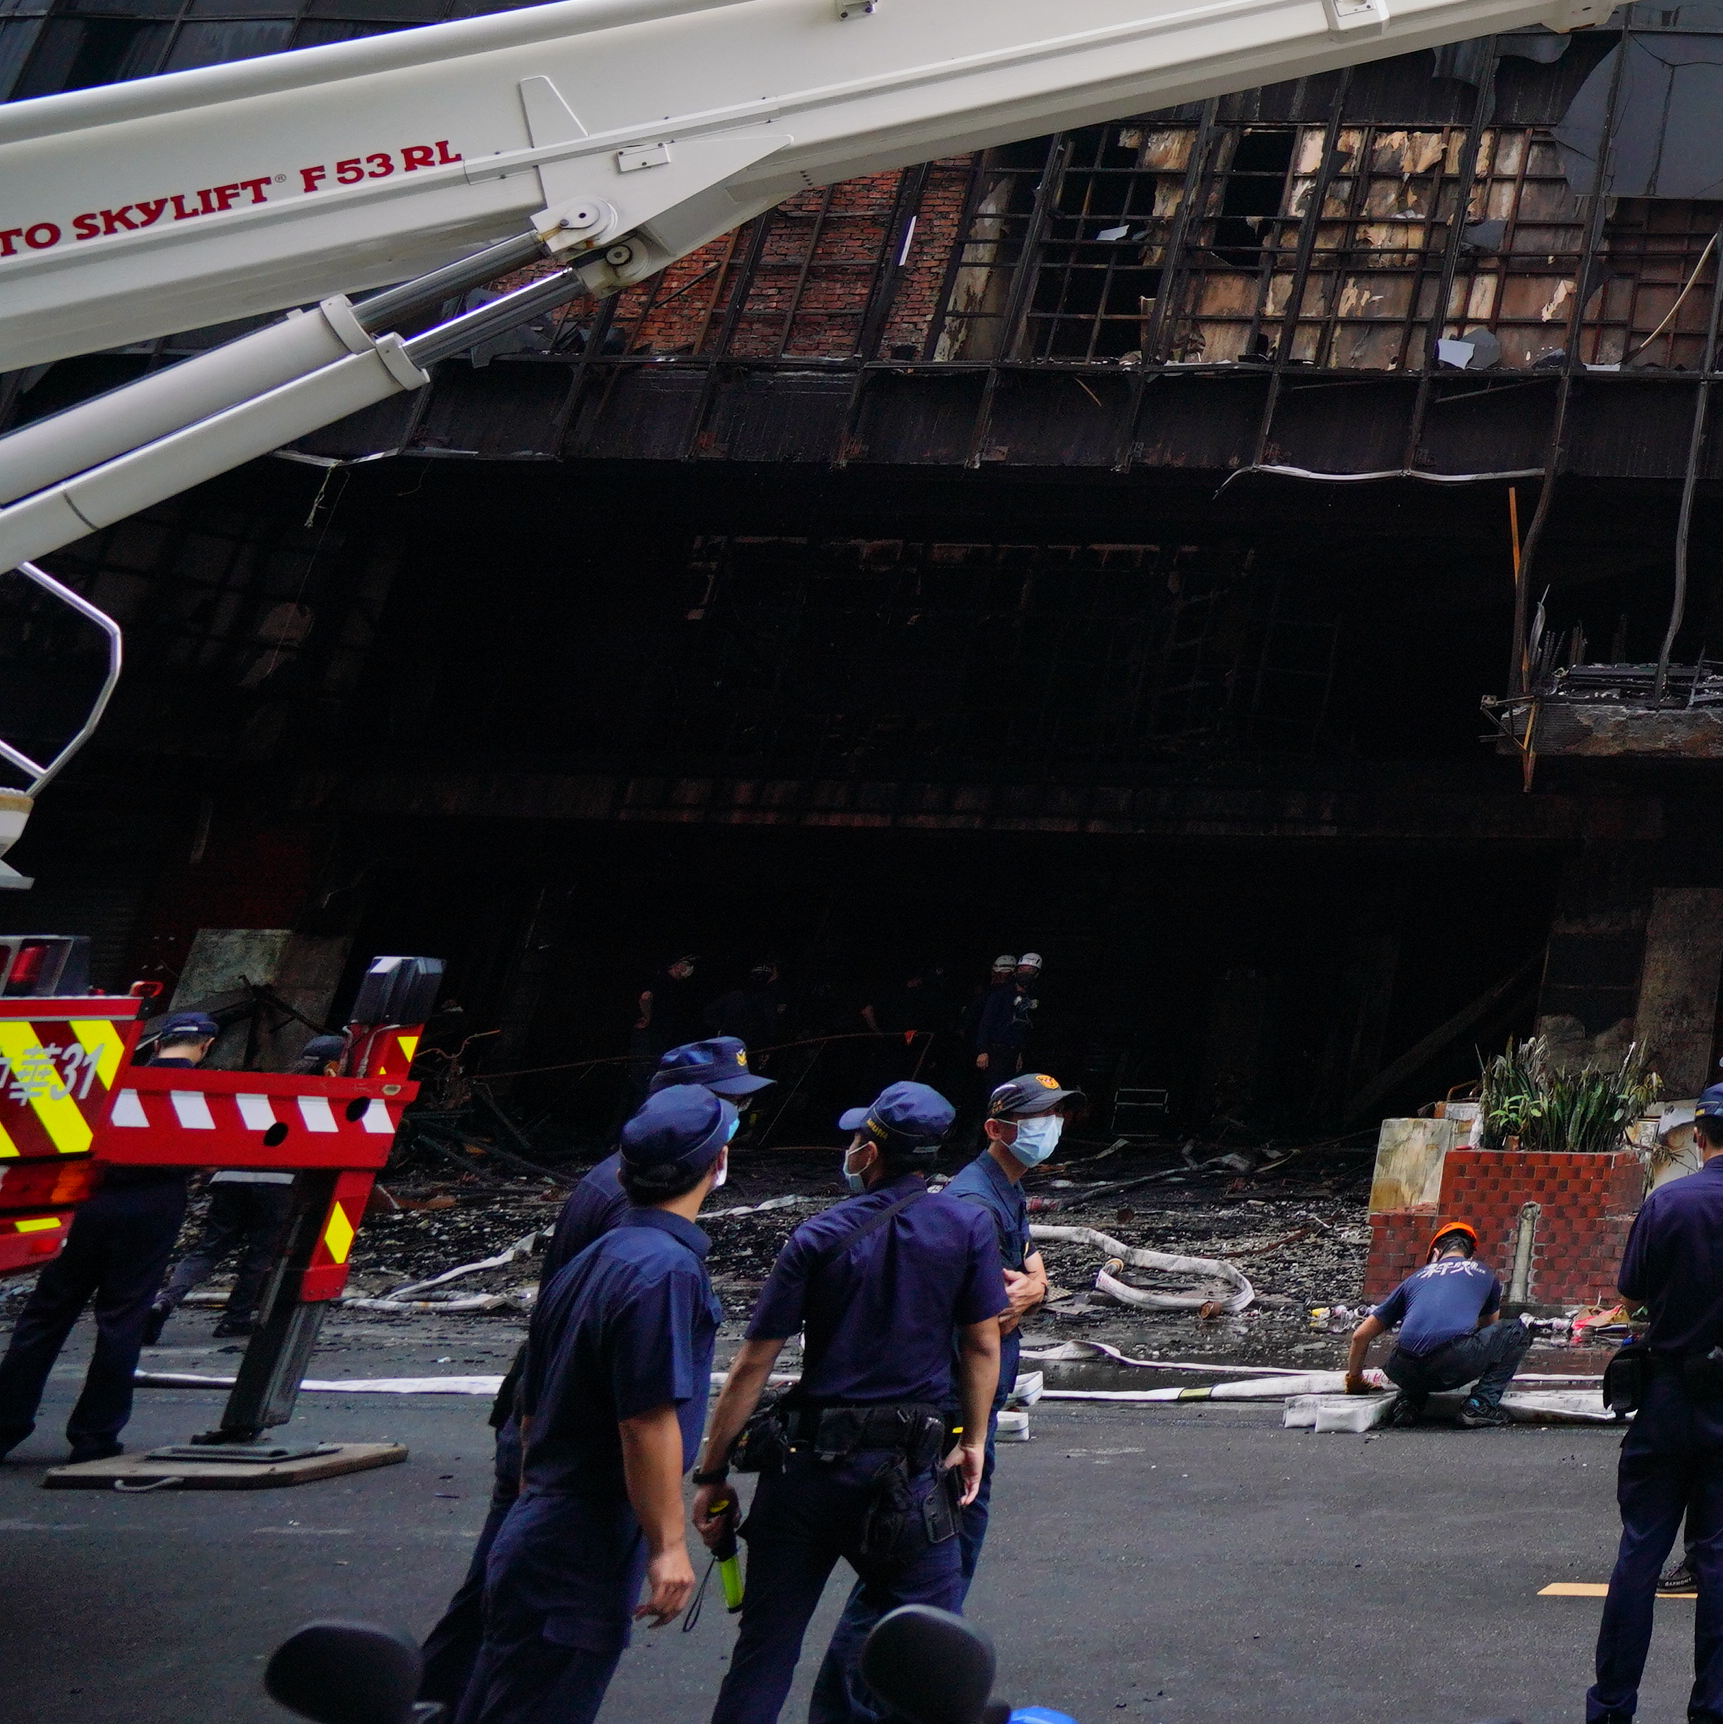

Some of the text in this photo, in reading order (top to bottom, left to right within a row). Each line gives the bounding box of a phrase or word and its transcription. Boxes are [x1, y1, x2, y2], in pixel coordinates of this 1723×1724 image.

[300, 165, 326, 193] F
[336, 152, 395, 185] 53
[400, 140, 462, 172] RL
